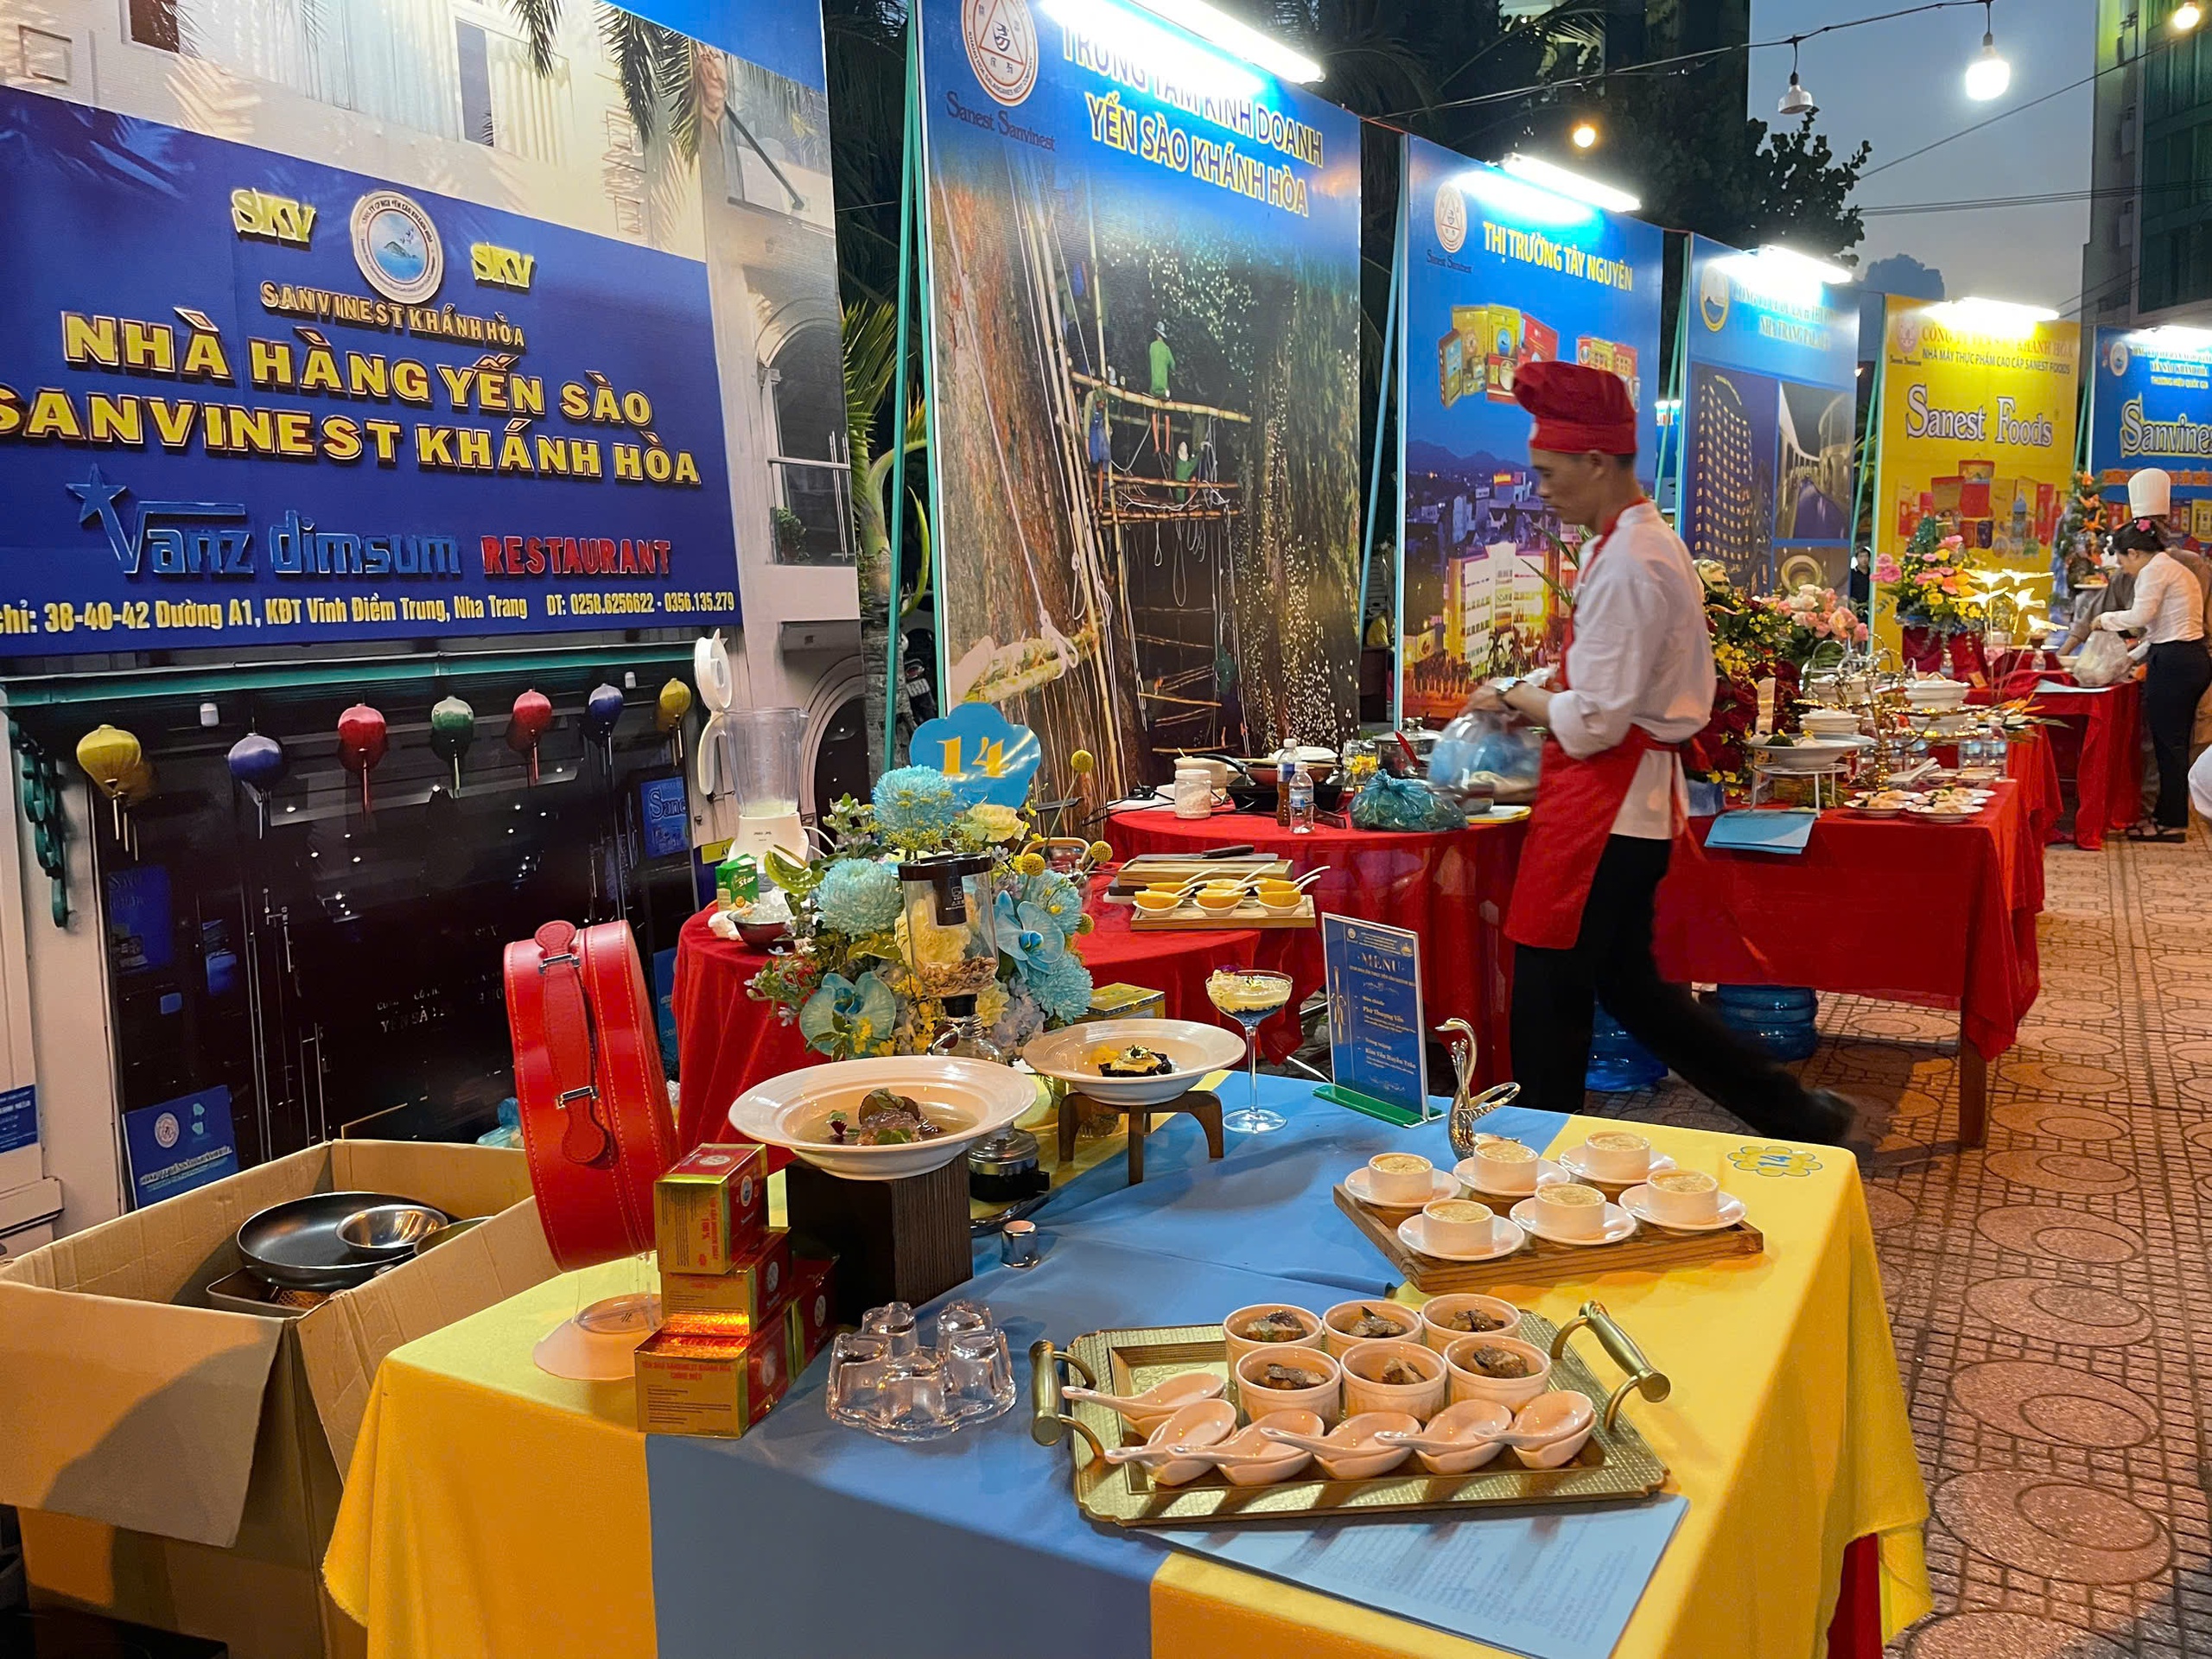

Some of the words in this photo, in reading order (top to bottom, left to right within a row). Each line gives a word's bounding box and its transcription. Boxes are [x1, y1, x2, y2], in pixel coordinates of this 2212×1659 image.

[946, 90, 995, 131] Sanest
[997, 109, 1056, 152] Sanvinest
[1204, 88, 1250, 136] KINH
[1256, 107, 1323, 168] DOANH
[1084, 91, 1138, 156] YẾN
[1140, 114, 1187, 172] SÀO
[1192, 136, 1265, 202] KHÁNH
[1268, 165, 1309, 218] HÒA
[1483, 220, 1507, 264] THỊ
[1507, 228, 1563, 274] TRƯỜNG
[1563, 244, 1587, 277] TÂY
[1586, 259, 1633, 292] NGUYÊN
[260, 280, 404, 331] SANVINEST
[408, 302, 484, 342] KHÁNH
[485, 310, 526, 347] HÒA
[60, 305, 235, 382] NHÀ
[246, 326, 431, 404] HÀNG
[435, 353, 545, 416] YẾN
[559, 370, 653, 428] SÀO
[1996, 355, 2010, 367] CAO
[0, 384, 403, 464] SANVINEST
[415, 418, 603, 480] KHÁNH
[613, 432, 702, 486] HÒA
[1906, 384, 1986, 442] Sanest
[1994, 396, 2054, 448] Foods
[2120, 393, 2212, 458] Sanvine
[270, 510, 461, 575] dimsum
[480, 534, 671, 575] RESTAURANT
[44, 601, 150, 633] 38-40-42
[229, 597, 261, 628] A1,
[265, 599, 302, 625] KĐT
[306, 595, 347, 624] Vĩnh
[351, 592, 396, 622] Điềm
[399, 596, 451, 623] Trung,
[454, 595, 485, 620] Nha
[487, 594, 529, 620] Trang
[570, 592, 656, 616] 0258.6256622
[664, 591, 735, 613] 0356.135.279
[937, 735, 1011, 782] 14
[738, 874, 756, 887] Star
